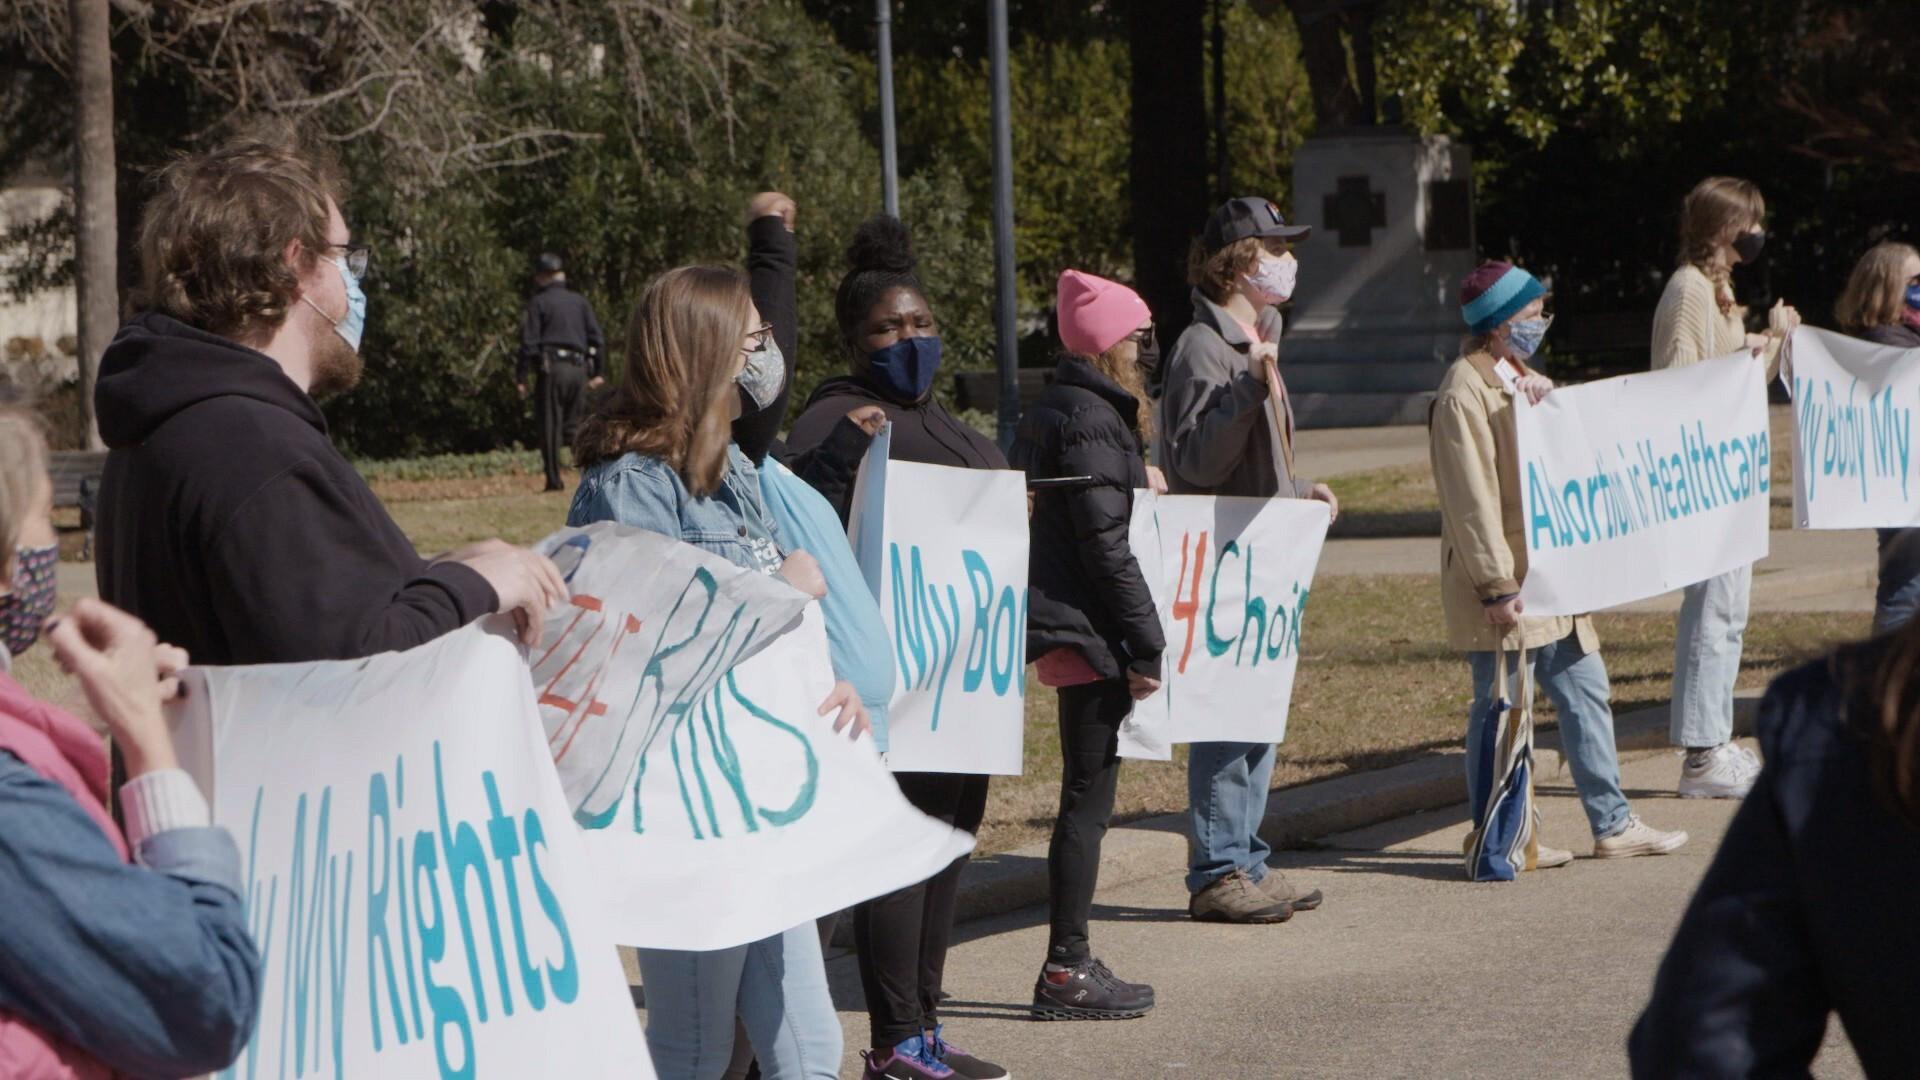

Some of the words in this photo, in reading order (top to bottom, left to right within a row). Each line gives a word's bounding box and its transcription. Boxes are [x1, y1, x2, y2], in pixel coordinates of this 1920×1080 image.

[1527, 449, 1640, 550] Abortion
[1616, 442, 1650, 529] is
[1636, 419, 1769, 525] Healthcare
[1823, 377, 1868, 502] Body
[1868, 384, 1910, 502] My
[890, 542, 961, 732] My
[1173, 530, 1208, 675] 4
[278, 785, 354, 1080] My
[367, 740, 580, 1080] Rights
